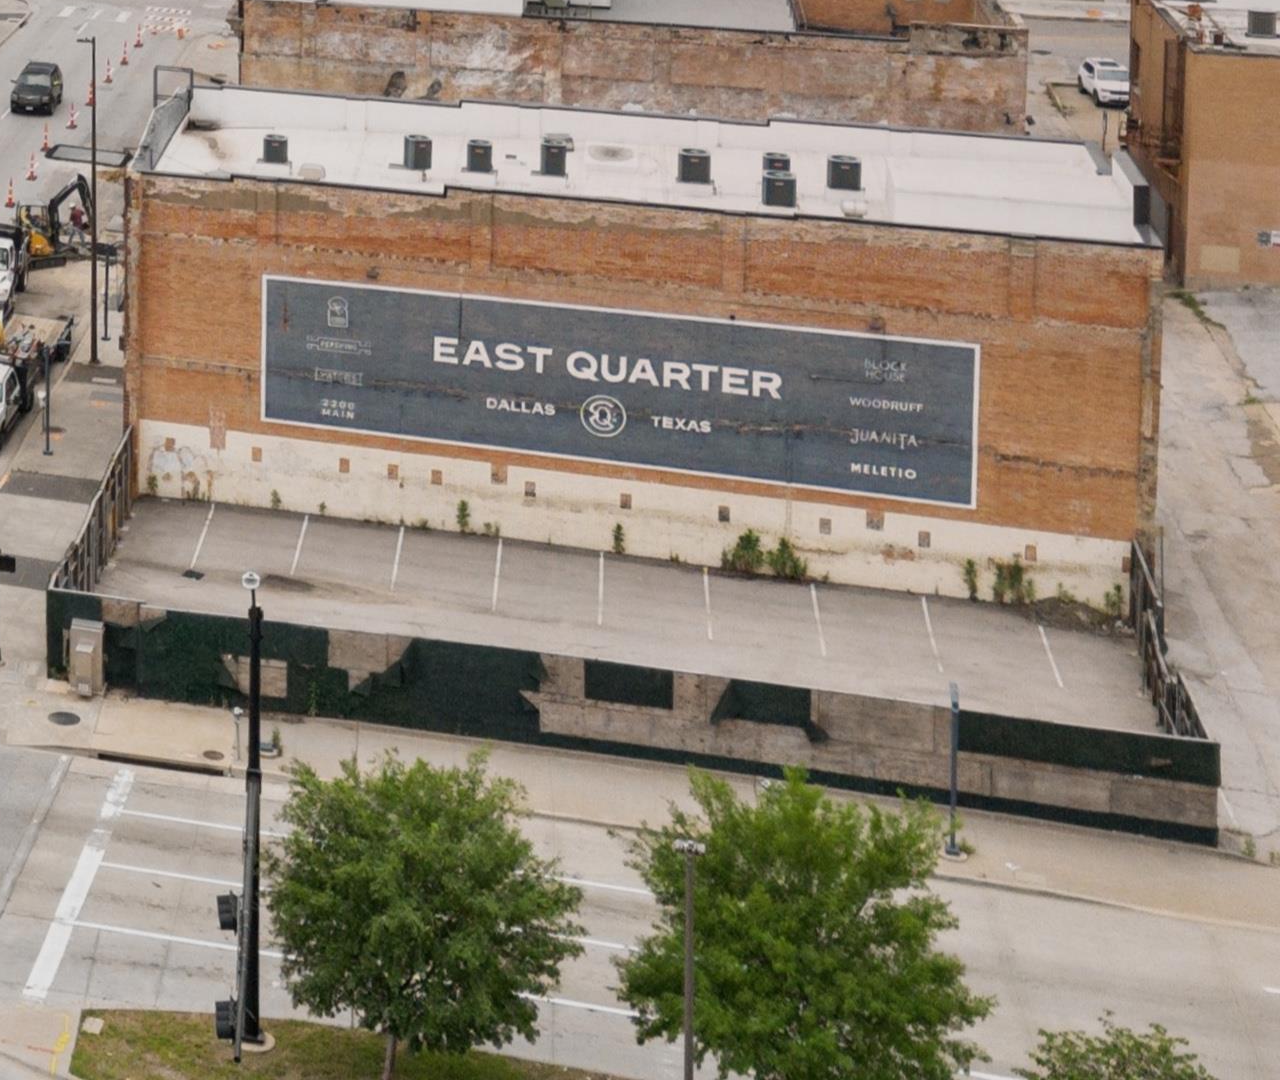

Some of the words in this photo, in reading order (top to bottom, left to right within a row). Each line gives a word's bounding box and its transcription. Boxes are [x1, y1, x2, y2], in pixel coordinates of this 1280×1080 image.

[432, 335, 553, 375] EAST
[566, 350, 783, 400] QUARTER
[863, 358, 907, 372] BLOCK
[321, 407, 356, 420] MAIN
[486, 397, 556, 417] DALLAS
[849, 396, 924, 413] WOODRUFF
[651, 415, 712, 434] TEXAS
[850, 428, 919, 450] JUANITA
[851, 463, 918, 479] MELETIO
